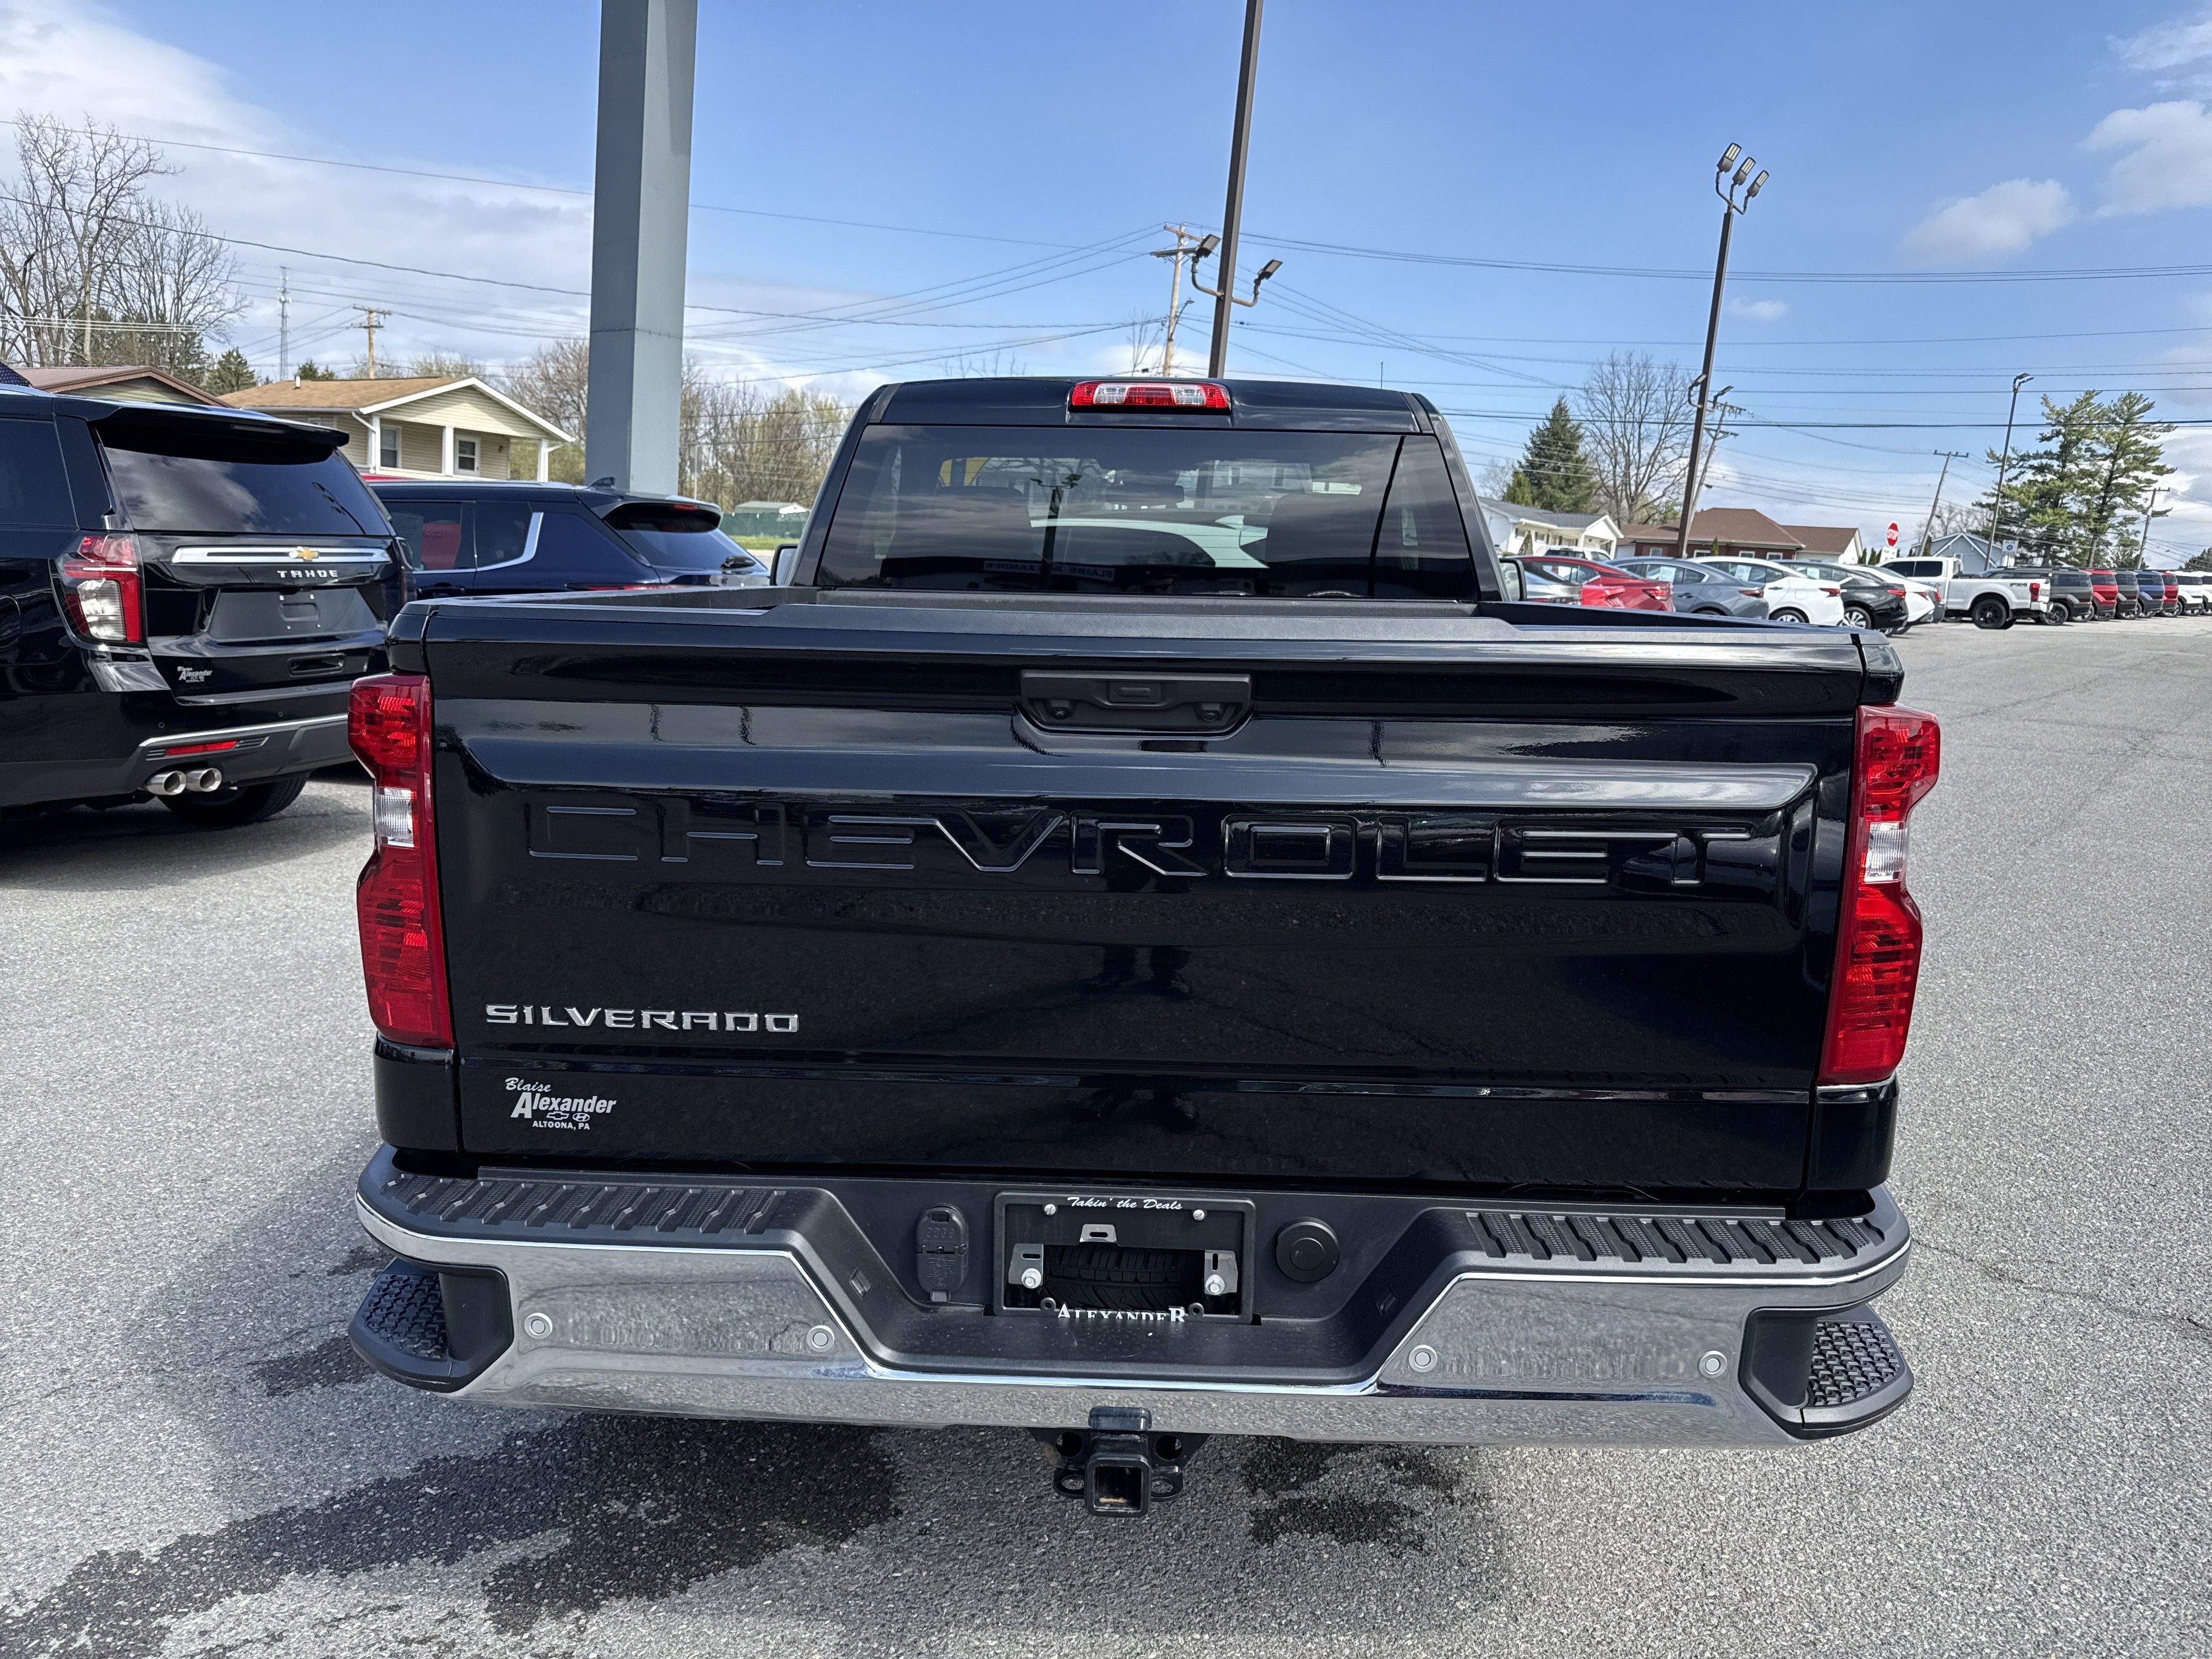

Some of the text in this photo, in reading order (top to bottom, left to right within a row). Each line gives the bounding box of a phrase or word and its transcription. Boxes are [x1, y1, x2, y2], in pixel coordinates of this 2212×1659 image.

[276, 569, 338, 578] TAHOE
[178, 669, 213, 681] Alexander
[526, 803, 1756, 886] CHEVROLET
[486, 1003, 799, 1032] SILVERADO
[505, 1077, 551, 1092] Blaise
[510, 1091, 617, 1119] Alexander
[532, 1120, 590, 1131] ALTOONA, PA
[1067, 1197, 1183, 1210] Takin' the Deals
